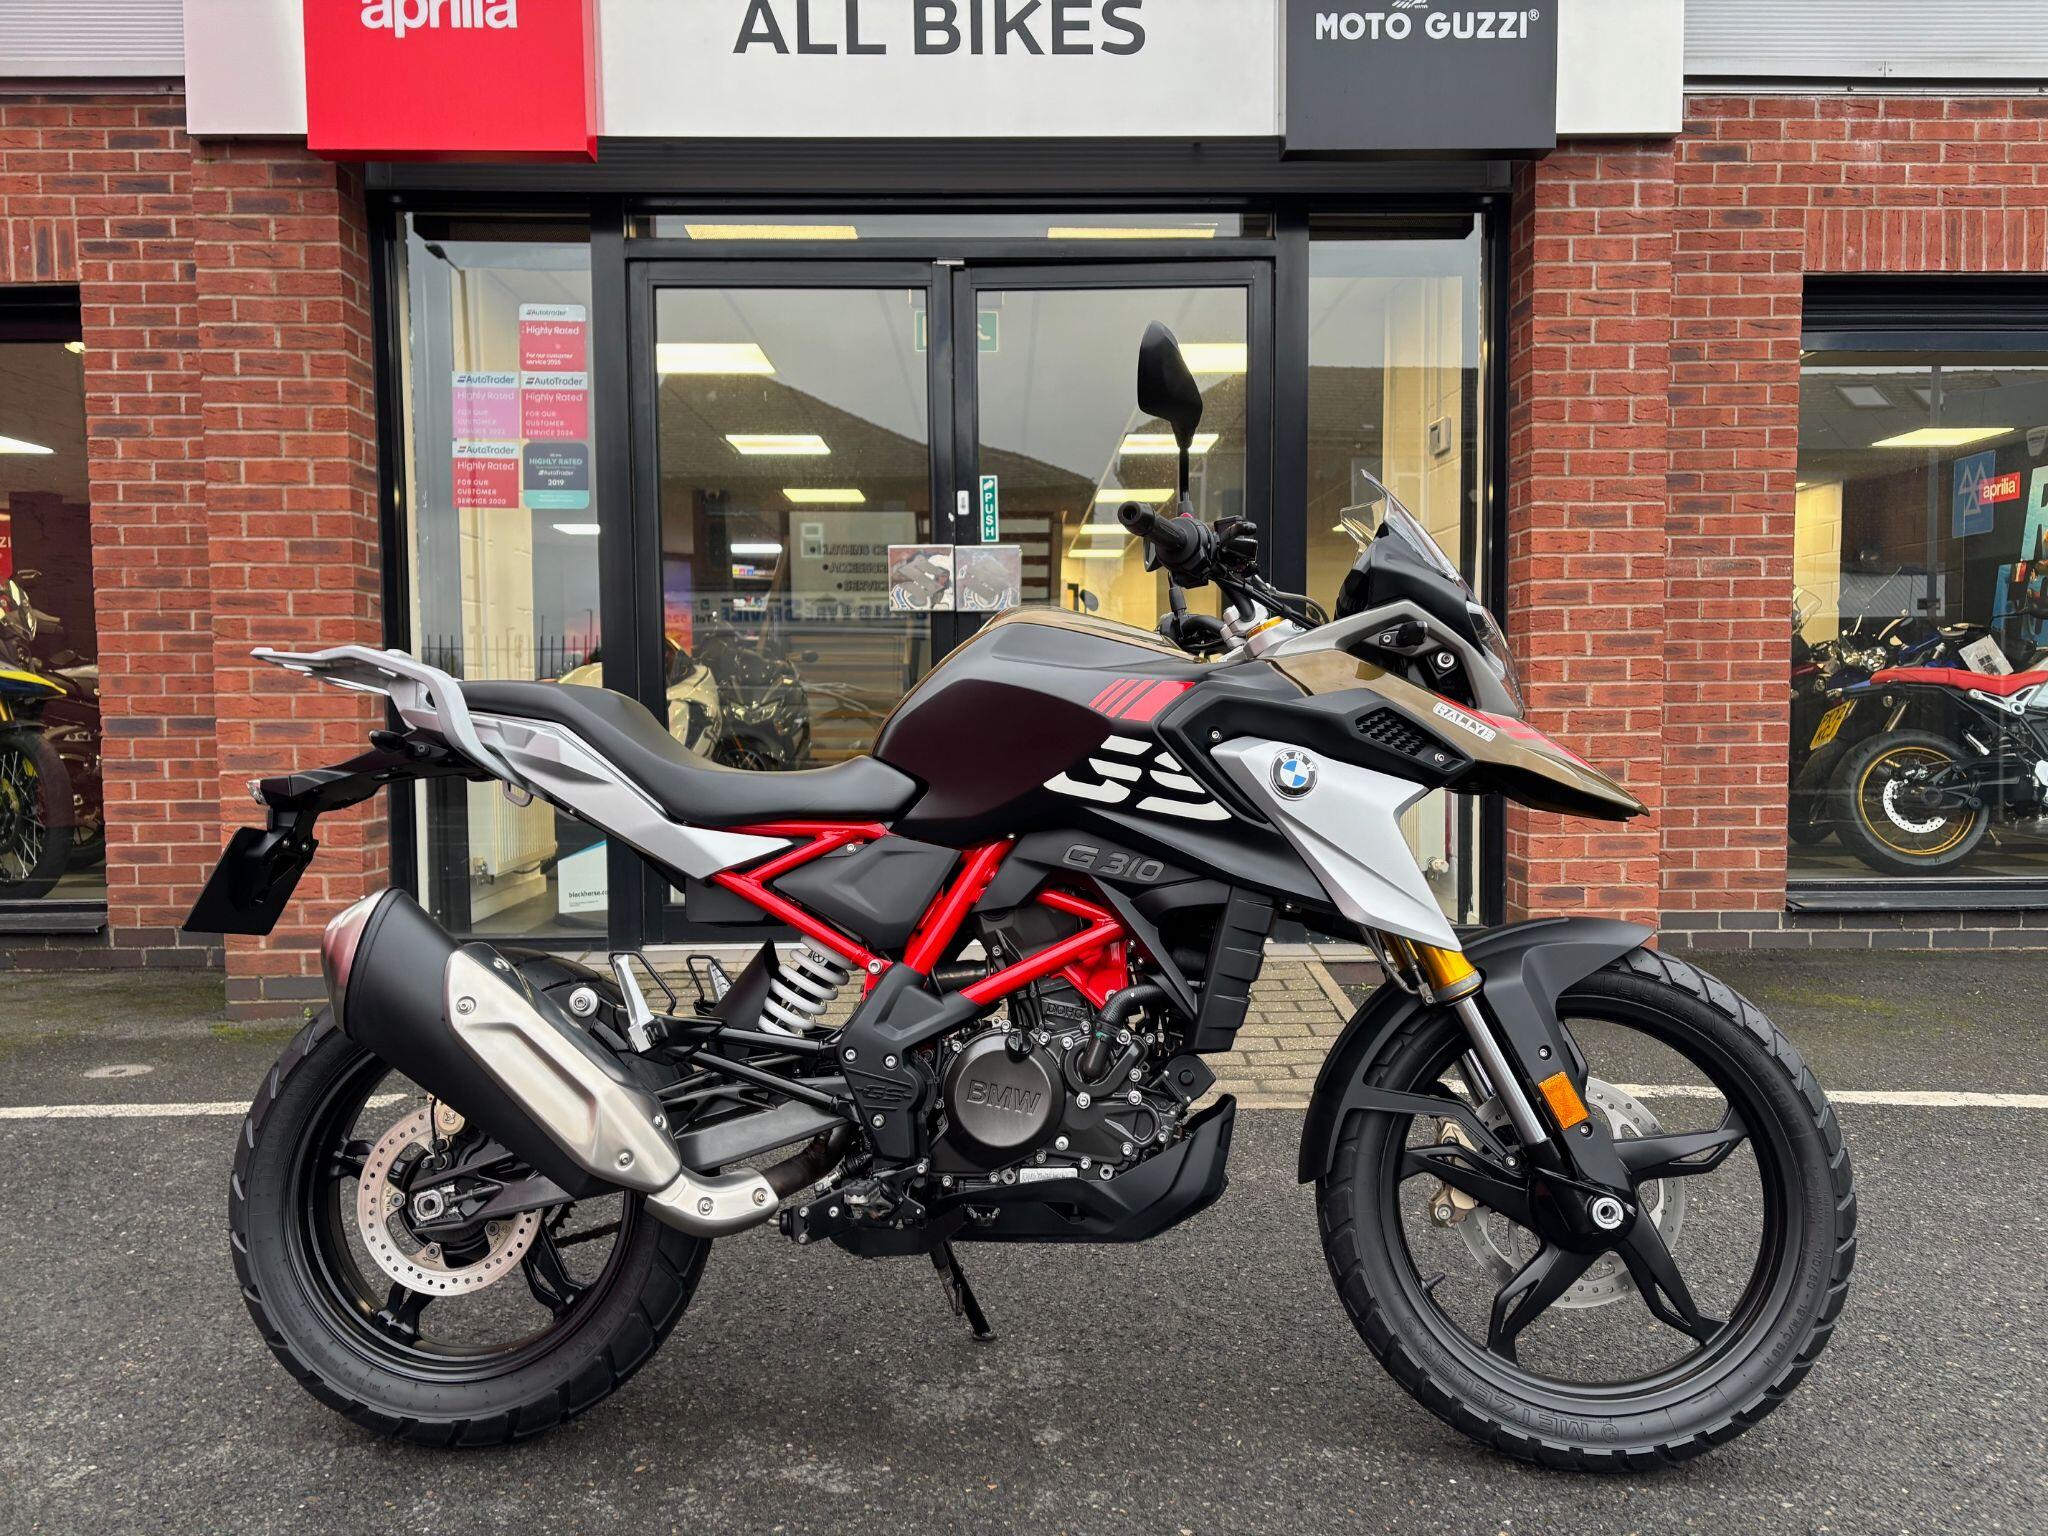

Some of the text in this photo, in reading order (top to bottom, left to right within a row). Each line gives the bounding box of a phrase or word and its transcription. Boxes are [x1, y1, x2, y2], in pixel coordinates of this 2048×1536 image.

[361, 0, 518, 38] aprilia
[733, 0, 1146, 56] ALL BIKES
[1315, 12, 1412, 40] MOTO
[526, 325, 580, 336] Highly Rated
[466, 375, 515, 384] AutoTrader
[534, 376, 583, 386] AutoTrader
[457, 391, 515, 401] Highly Rated
[525, 392, 583, 403] Highly Rated
[466, 446, 515, 455] AutoTrader
[457, 460, 515, 471] Highly Rated
[547, 478, 564, 487] 2019
[1983, 476, 2016, 502] aprilia
[984, 492, 995, 537] PUSH
[1062, 843, 1165, 881] G 310
[966, 1079, 1042, 1116] BMW
